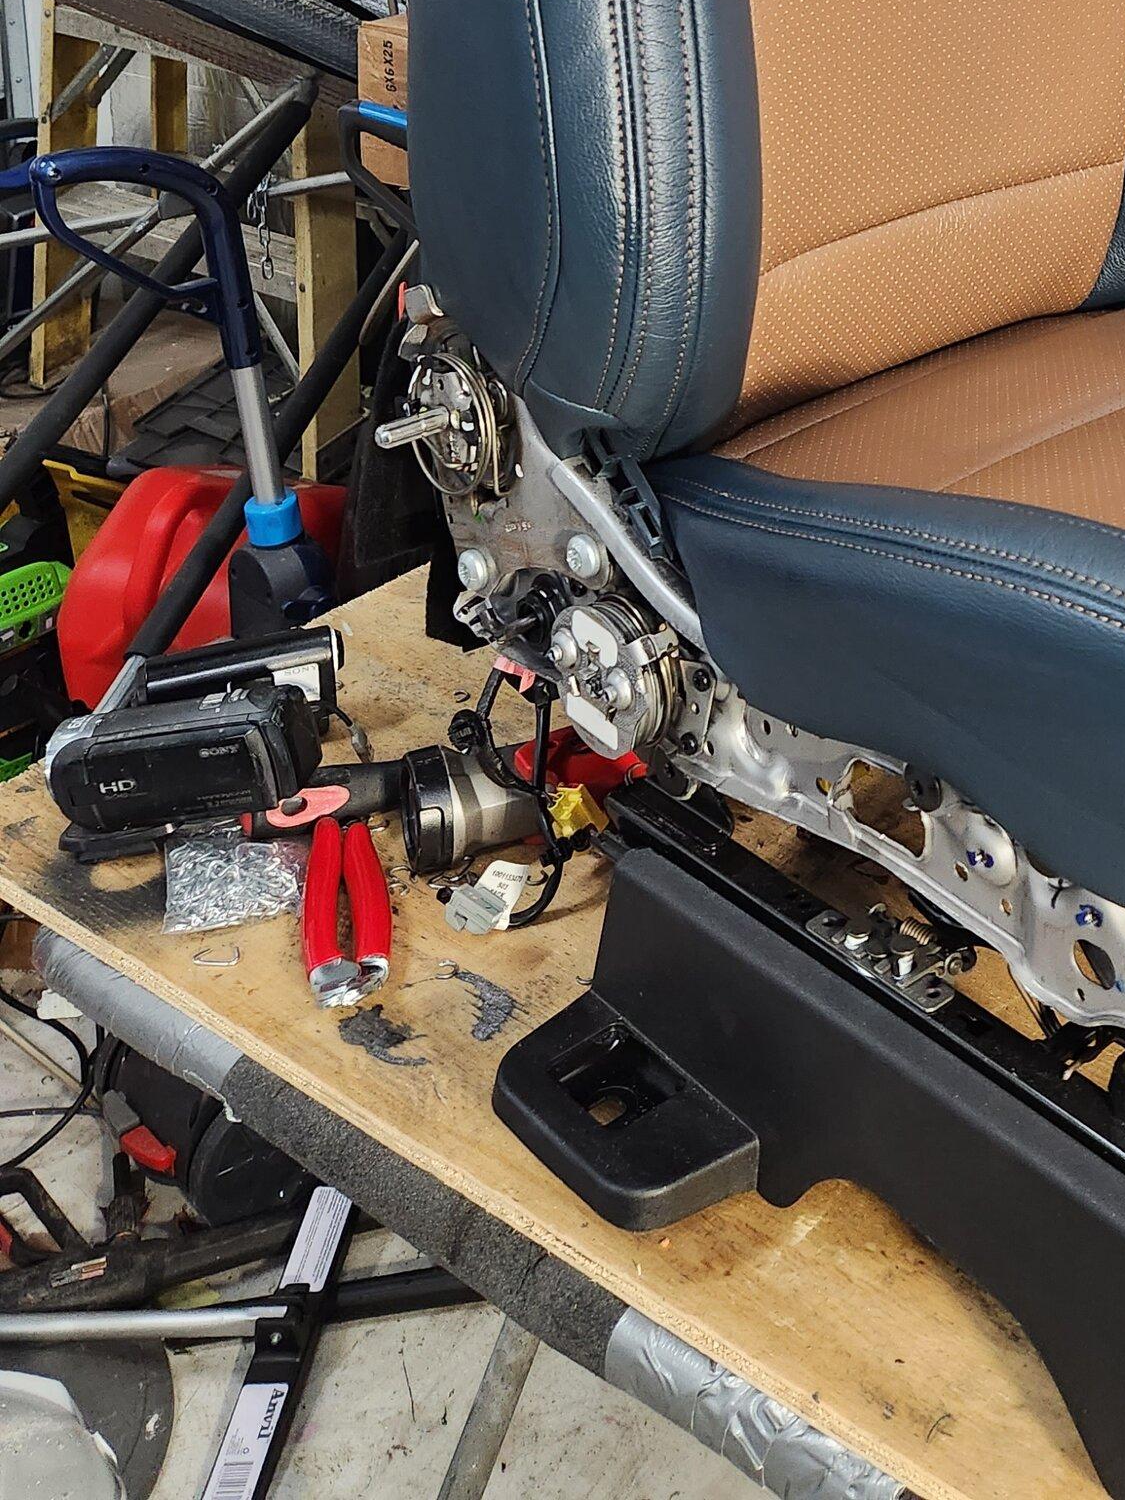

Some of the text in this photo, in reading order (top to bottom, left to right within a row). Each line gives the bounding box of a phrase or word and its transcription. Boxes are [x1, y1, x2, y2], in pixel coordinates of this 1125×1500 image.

[200, 743, 240, 758] SONY
[99, 779, 136, 794] HD
[257, 1388, 286, 1440] Anvil
